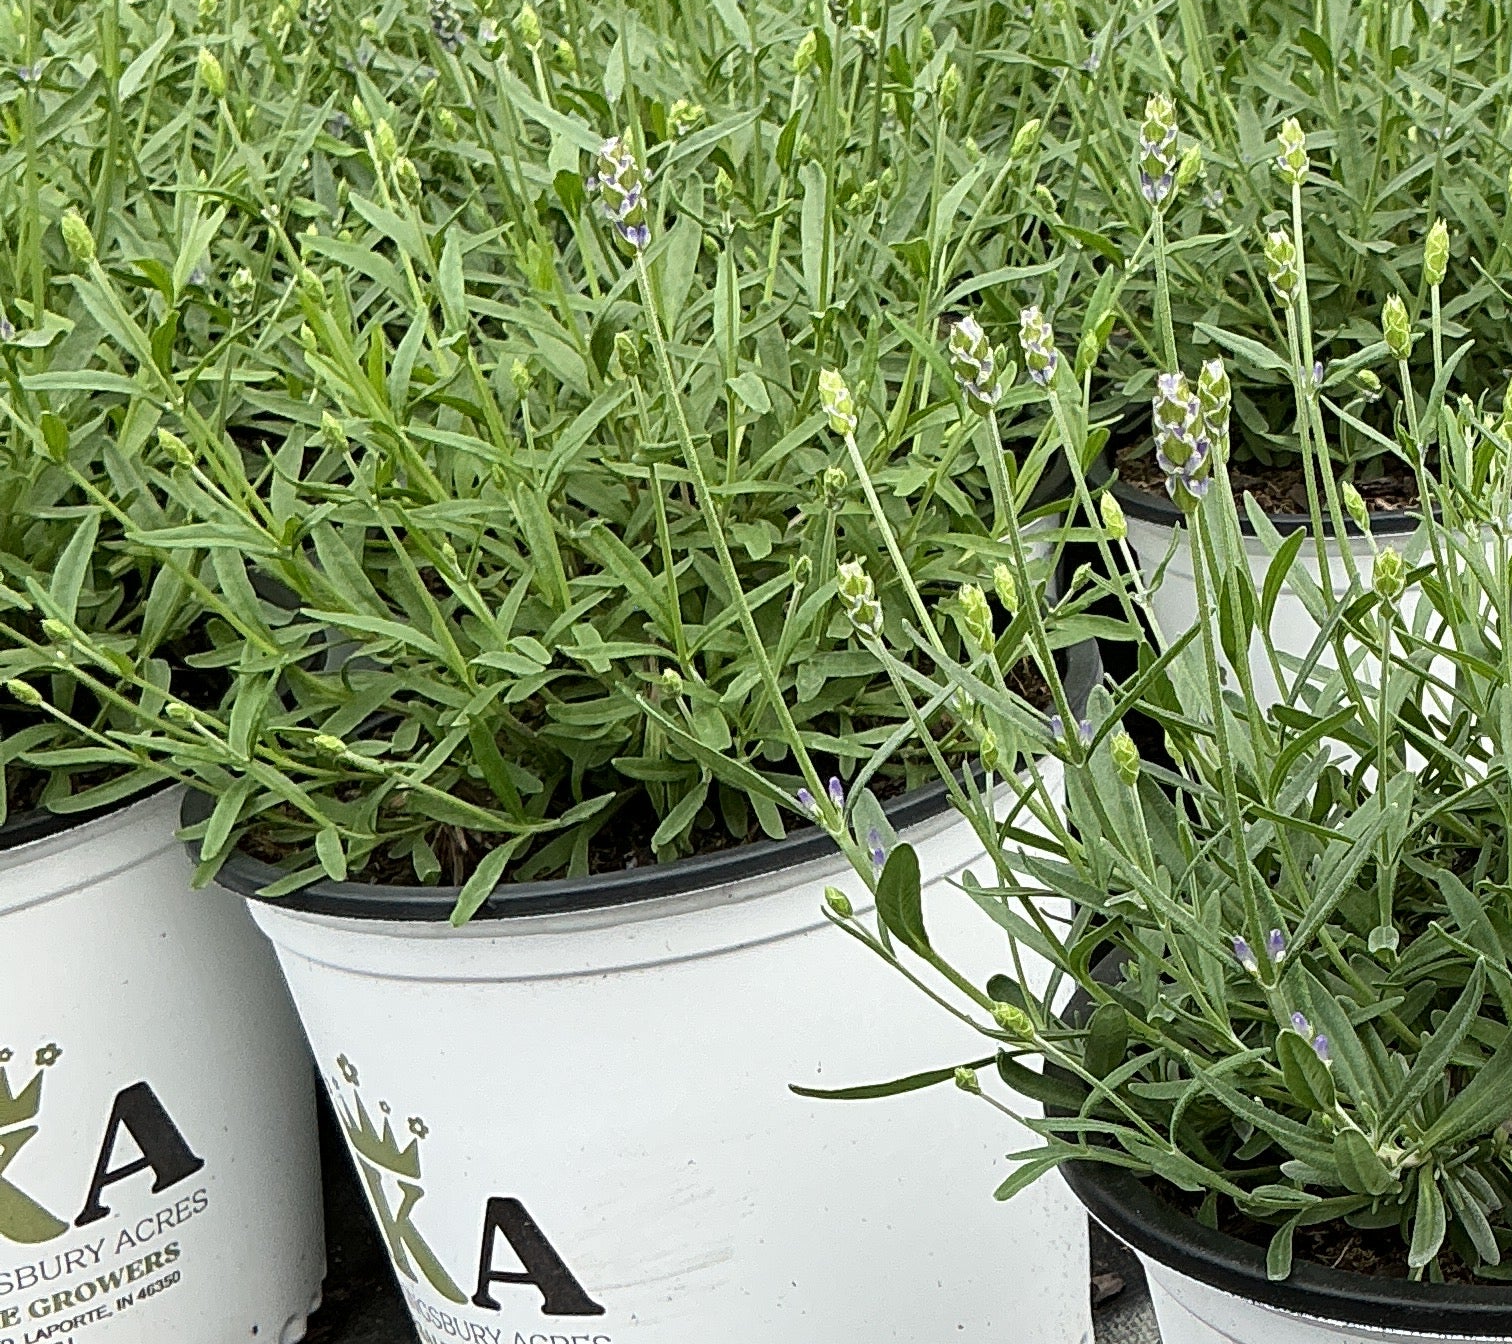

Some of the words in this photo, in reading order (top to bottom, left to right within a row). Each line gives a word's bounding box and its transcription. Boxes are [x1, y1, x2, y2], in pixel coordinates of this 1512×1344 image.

[114, 1188, 209, 1254] ACRES
[28, 1241, 181, 1320] GROWERS
[116, 1292, 134, 1312] IN
[136, 1269, 181, 1301] 46350
